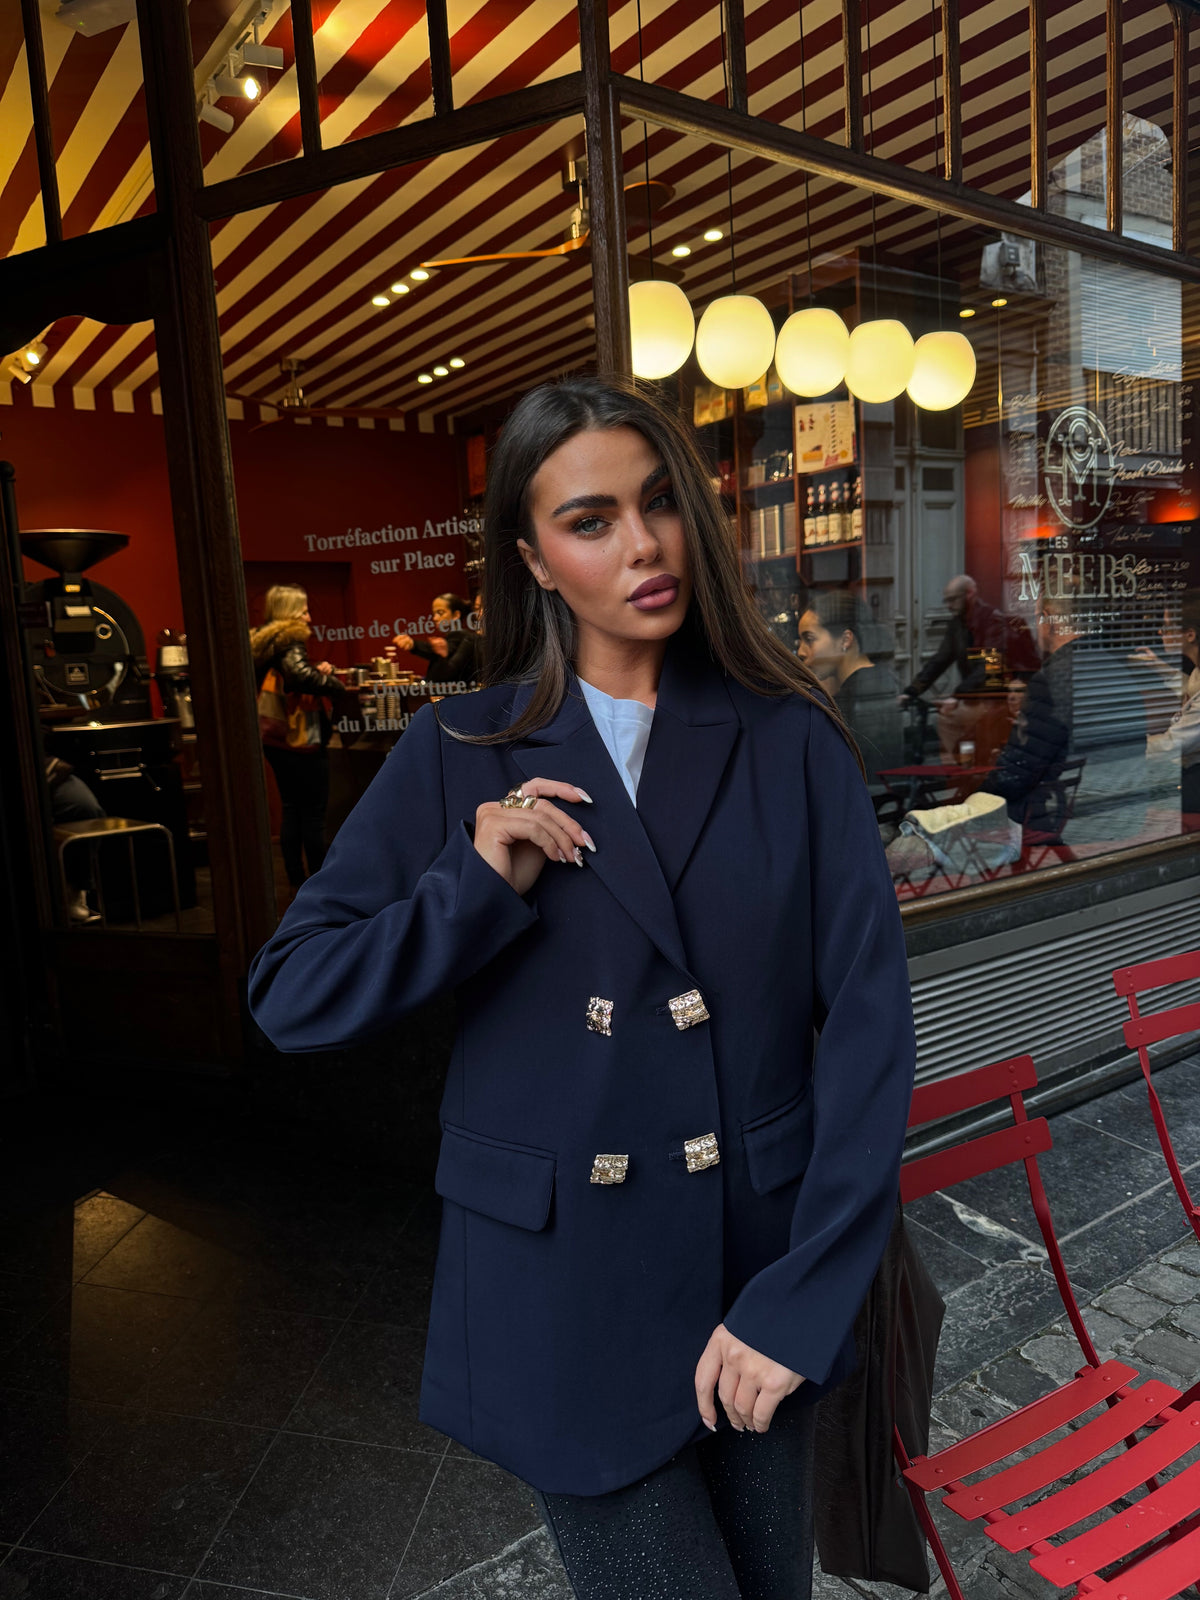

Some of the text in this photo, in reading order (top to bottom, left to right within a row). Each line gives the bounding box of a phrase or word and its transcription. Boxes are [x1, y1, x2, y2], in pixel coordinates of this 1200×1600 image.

[304, 525, 419, 552] Torréfaction
[1048, 536, 1069, 549] LES
[371, 551, 456, 575] sur Place
[1018, 553, 1138, 601] MEERS
[313, 625, 364, 642] Vente
[368, 620, 391, 638] de
[394, 615, 436, 637] Café
[439, 617, 462, 632] en
[373, 680, 467, 699] Ouverture
[338, 715, 360, 733] du
